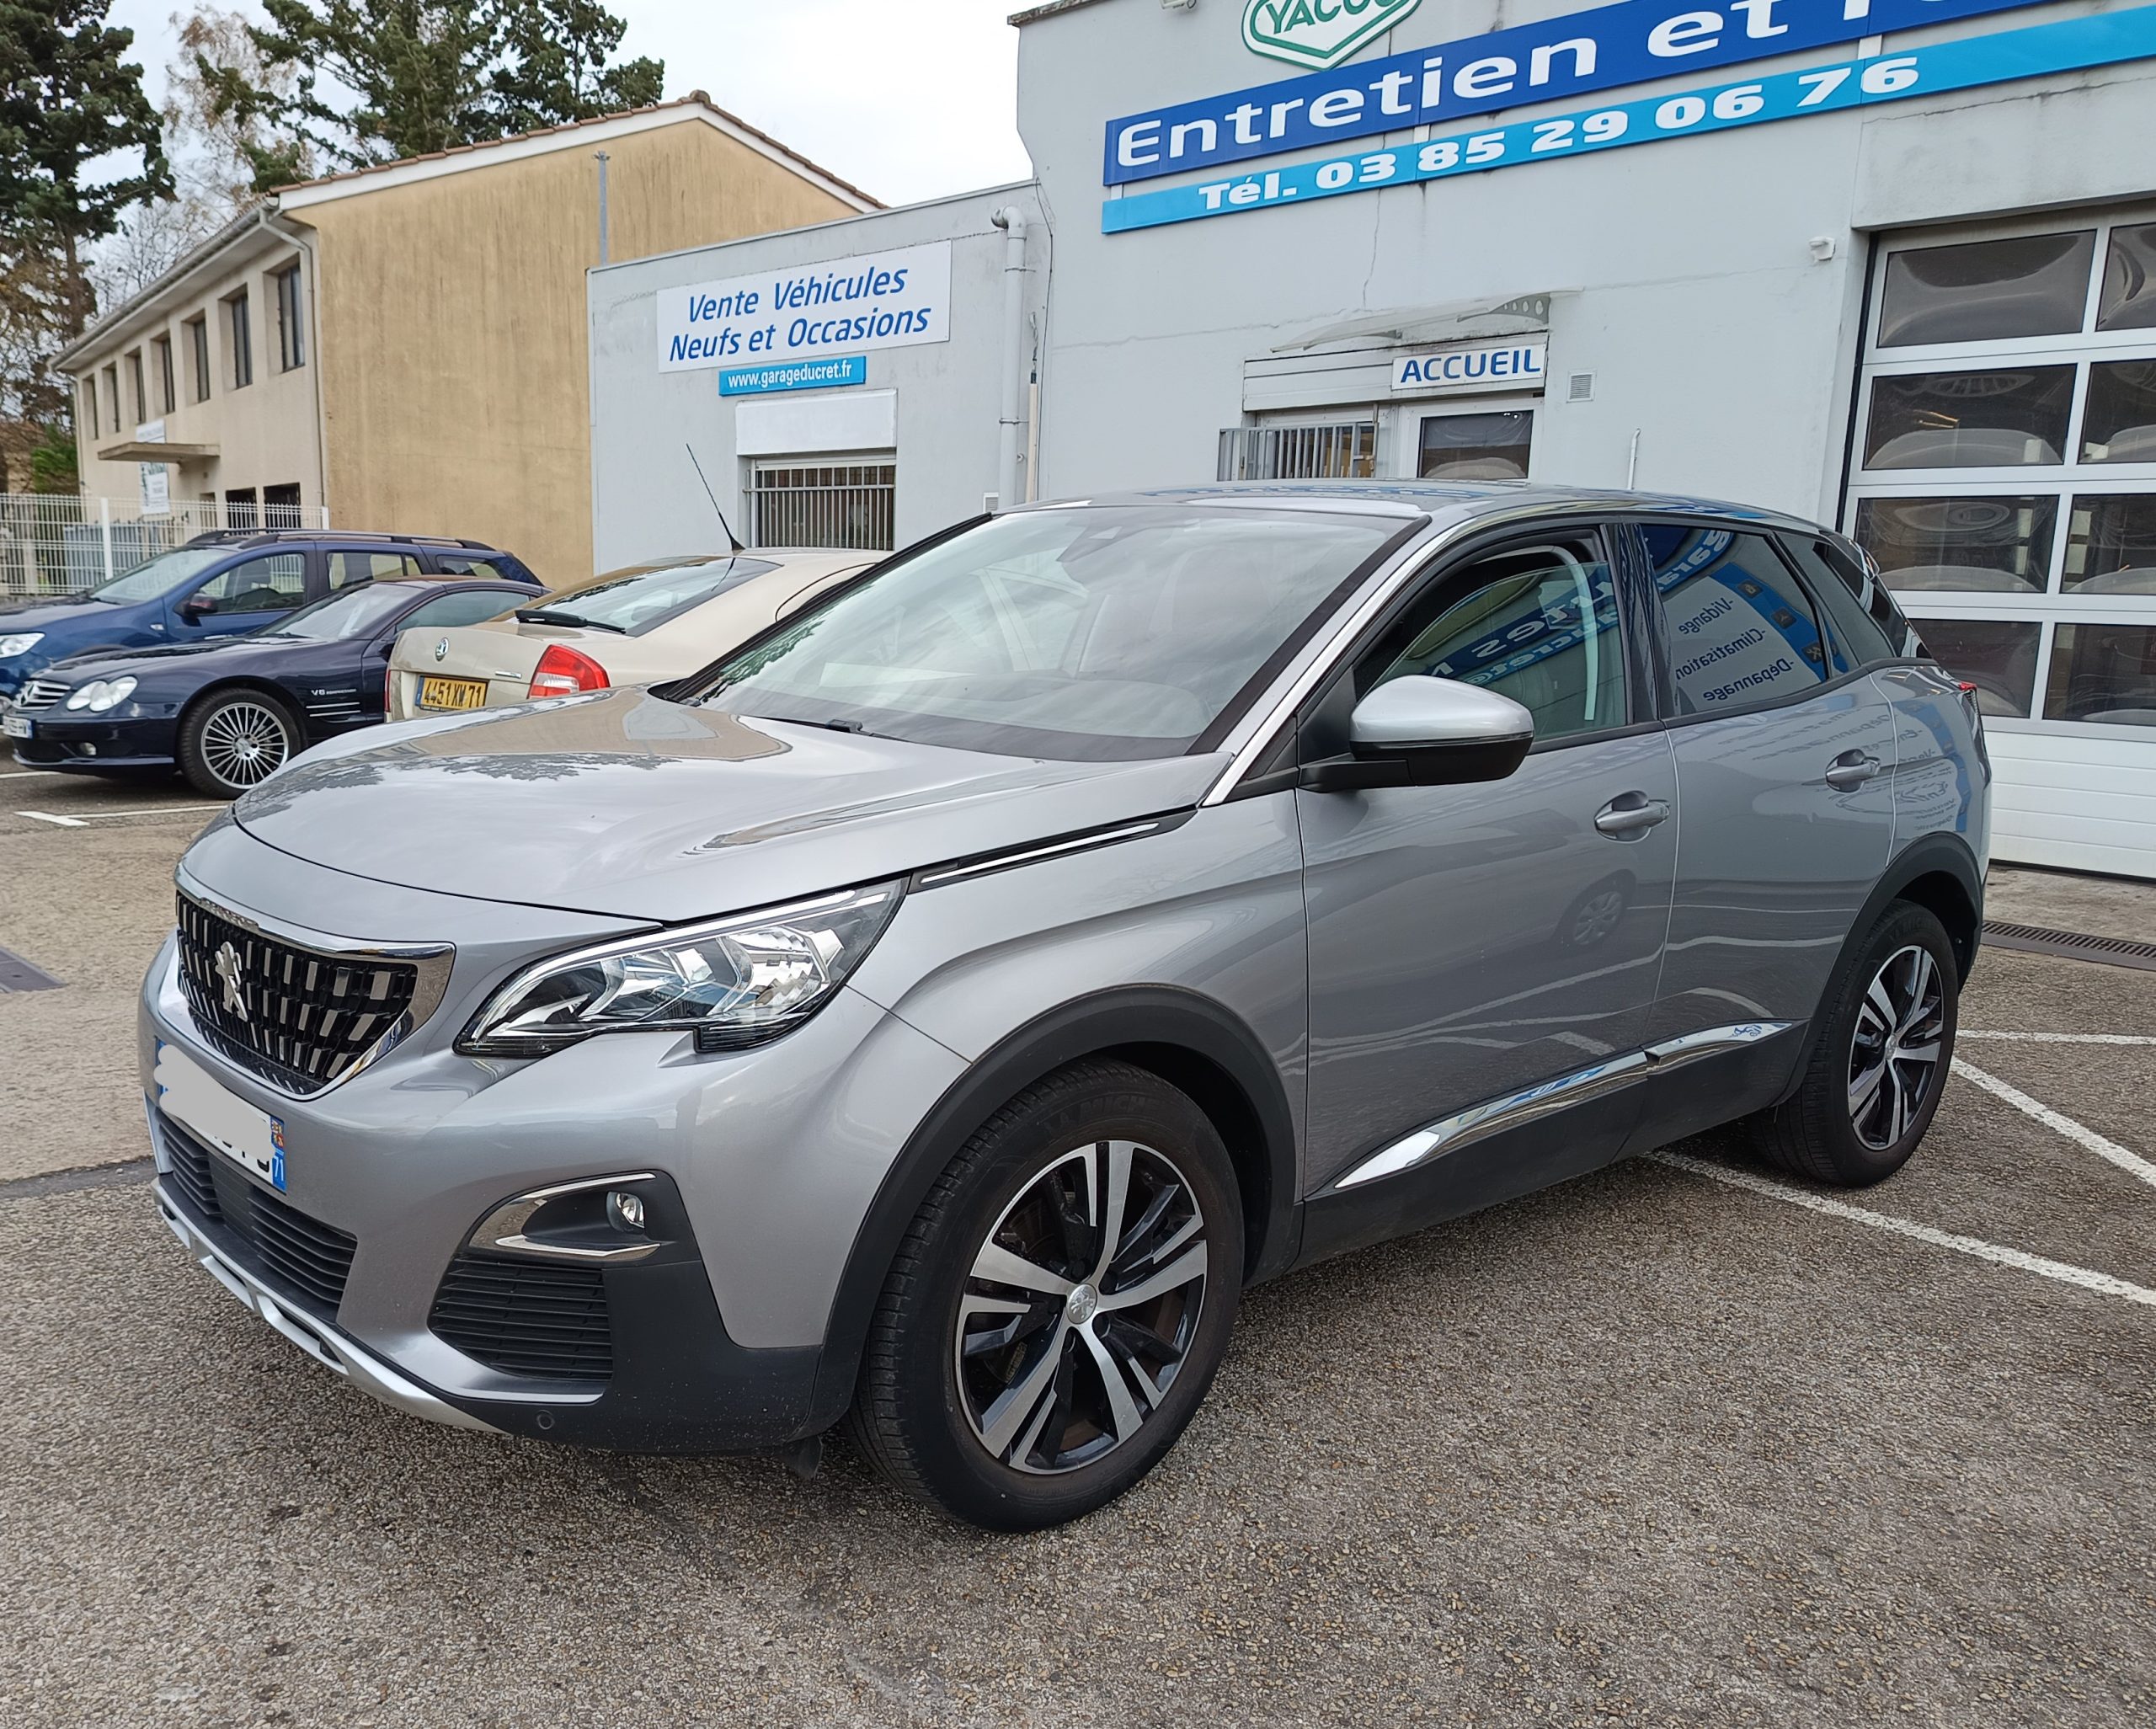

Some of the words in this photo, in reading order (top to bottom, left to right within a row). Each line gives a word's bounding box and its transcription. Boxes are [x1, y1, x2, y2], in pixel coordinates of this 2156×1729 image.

[1266, 0, 1394, 35] YAC
[1117, 36, 1597, 167] Entretien
[1647, 0, 1789, 57] et
[1198, 173, 1297, 210] Tél.
[1315, 153, 1396, 189] 03
[1417, 131, 1506, 172] 85
[1530, 109, 1629, 153] 29
[1655, 84, 1765, 130] 06
[1796, 56, 1919, 107] 76
[689, 291, 759, 323] Vente
[774, 266, 908, 310] Véhicules
[670, 328, 741, 361] Neufs
[748, 324, 776, 351] et
[787, 307, 931, 347] Occasions
[728, 359, 852, 388] www.garageducret.fr
[1400, 349, 1540, 383] ACCUEIL
[273, 1155, 284, 1182] 71
